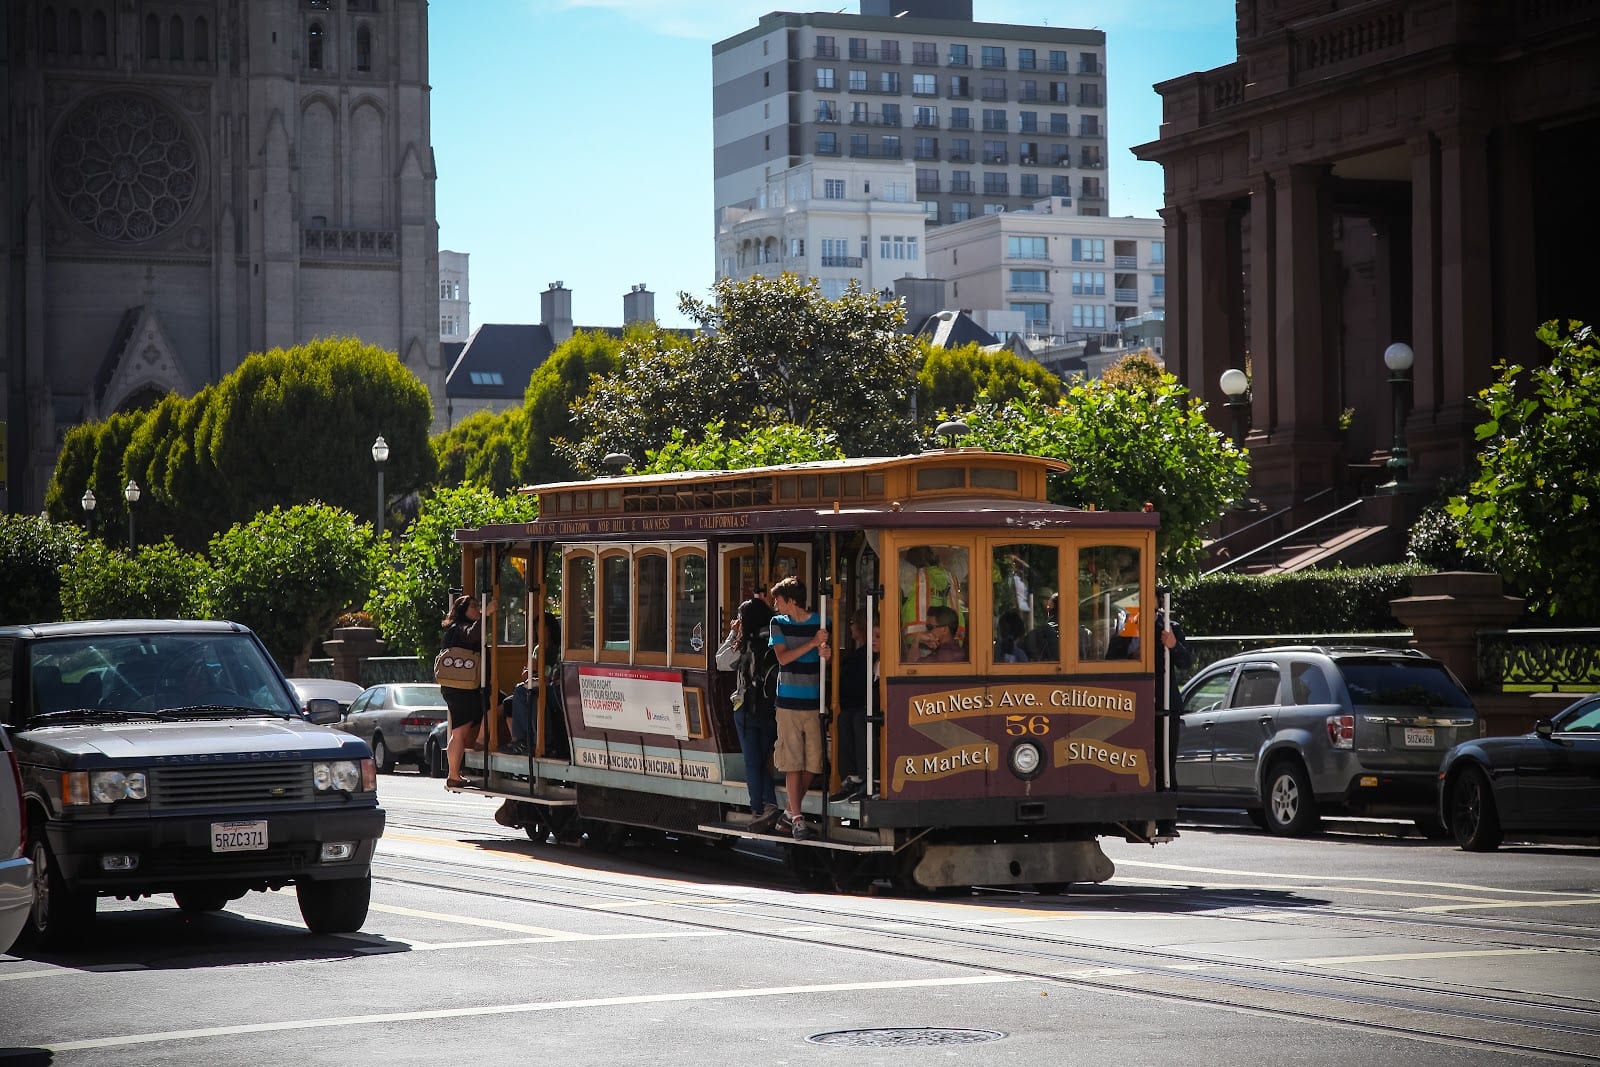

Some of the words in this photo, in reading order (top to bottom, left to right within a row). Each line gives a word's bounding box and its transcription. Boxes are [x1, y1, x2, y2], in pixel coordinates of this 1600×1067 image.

[612, 520, 625, 532] HILL
[654, 518, 670, 530] NESS
[699, 515, 739, 529] CALIFORNIA
[913, 699, 946, 717] Van
[948, 694, 993, 712] Ness
[1050, 689, 1133, 712] California
[1005, 715, 1050, 736] 56
[155, 754, 223, 763] RANGE
[237, 751, 303, 760] ROVER
[582, 751, 597, 764] SAN
[598, 754, 638, 769] FRANCISCO
[904, 757, 917, 775] &
[922, 747, 990, 774] Market
[1068, 742, 1137, 767] Streets
[215, 832, 264, 848] 5RZC371
